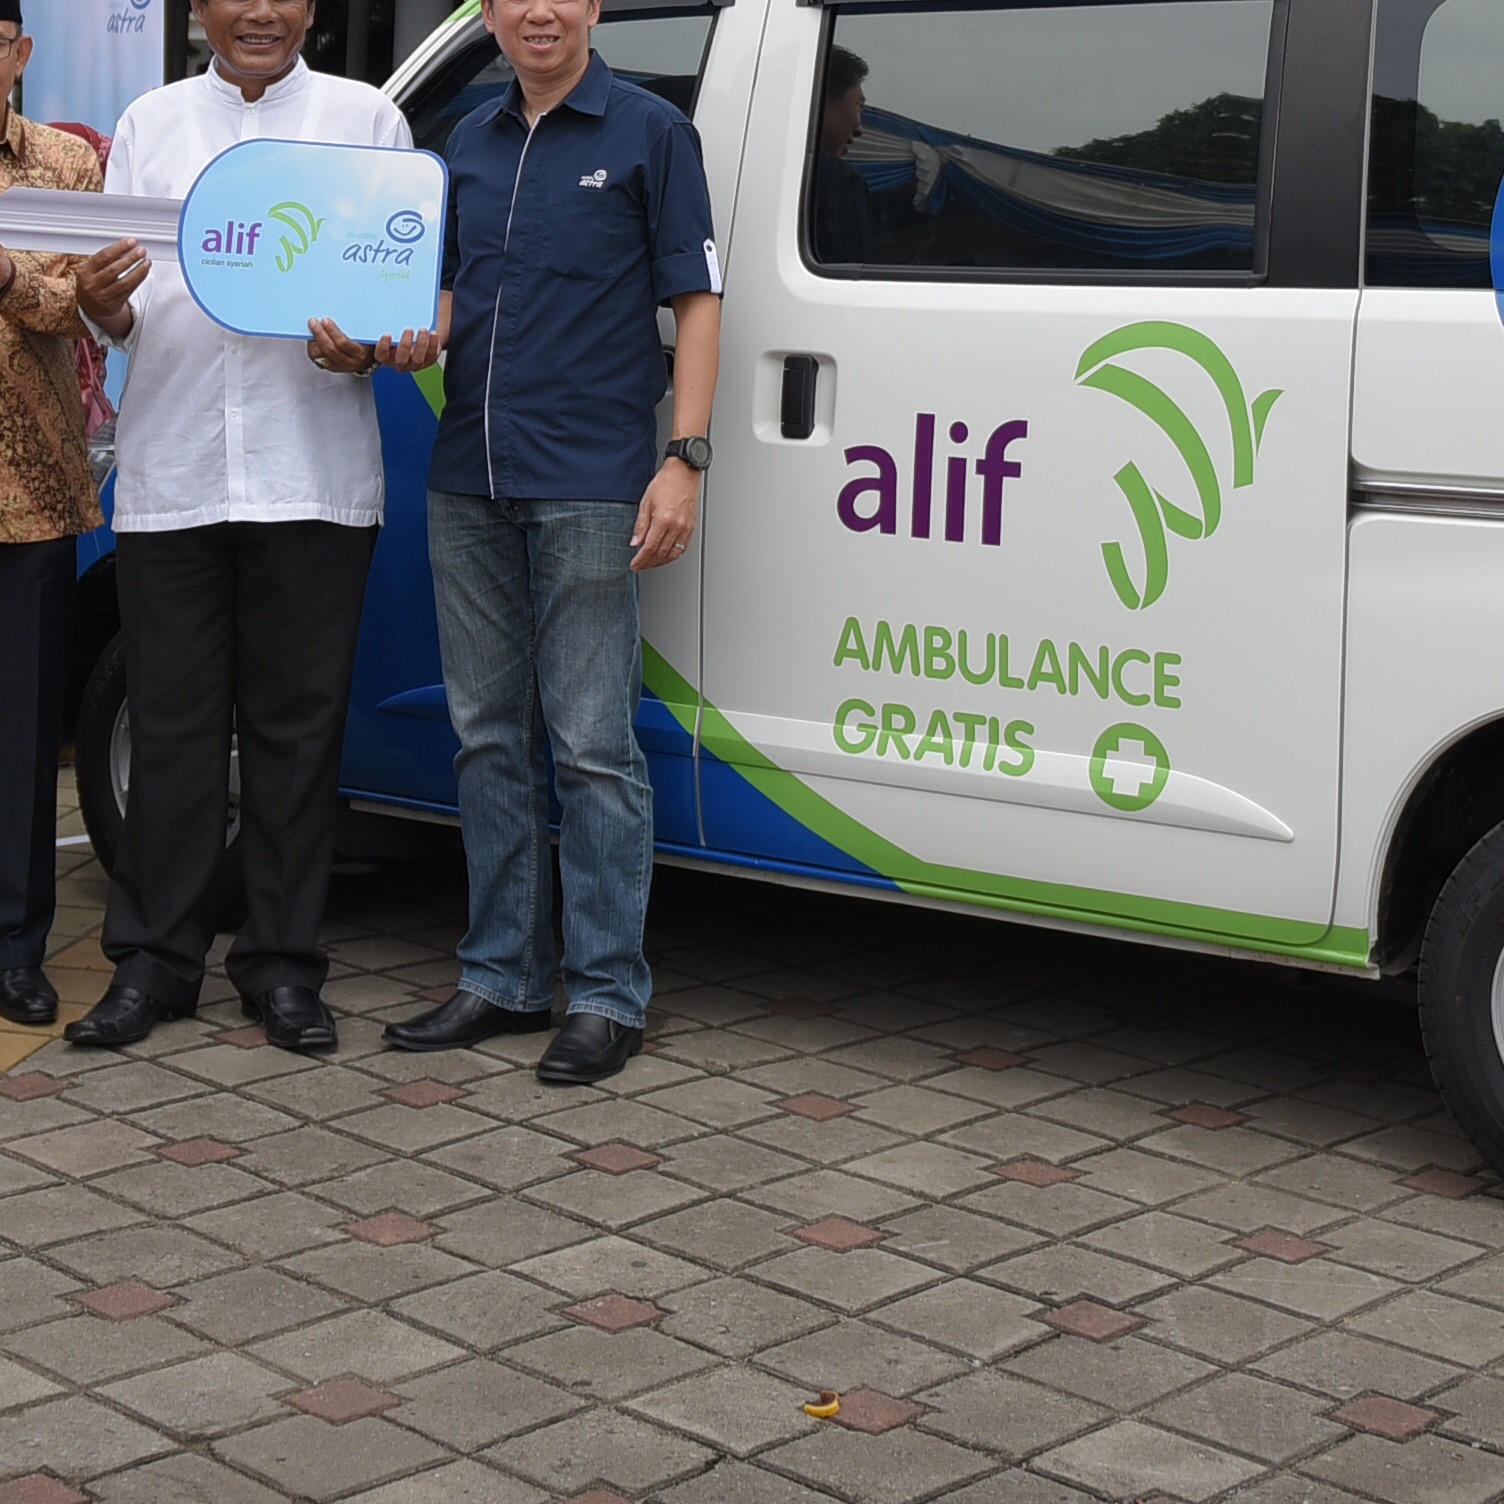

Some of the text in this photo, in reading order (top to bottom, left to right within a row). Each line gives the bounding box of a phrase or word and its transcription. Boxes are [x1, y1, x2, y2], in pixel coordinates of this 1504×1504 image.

[106, 6, 146, 34] astra
[200, 220, 263, 256] alif
[342, 239, 415, 267] astra
[200, 258, 254, 269] cicilan syariah
[836, 411, 1029, 547] alif
[832, 616, 1183, 710] AMBULANCE
[832, 697, 1036, 777] GRATIS
